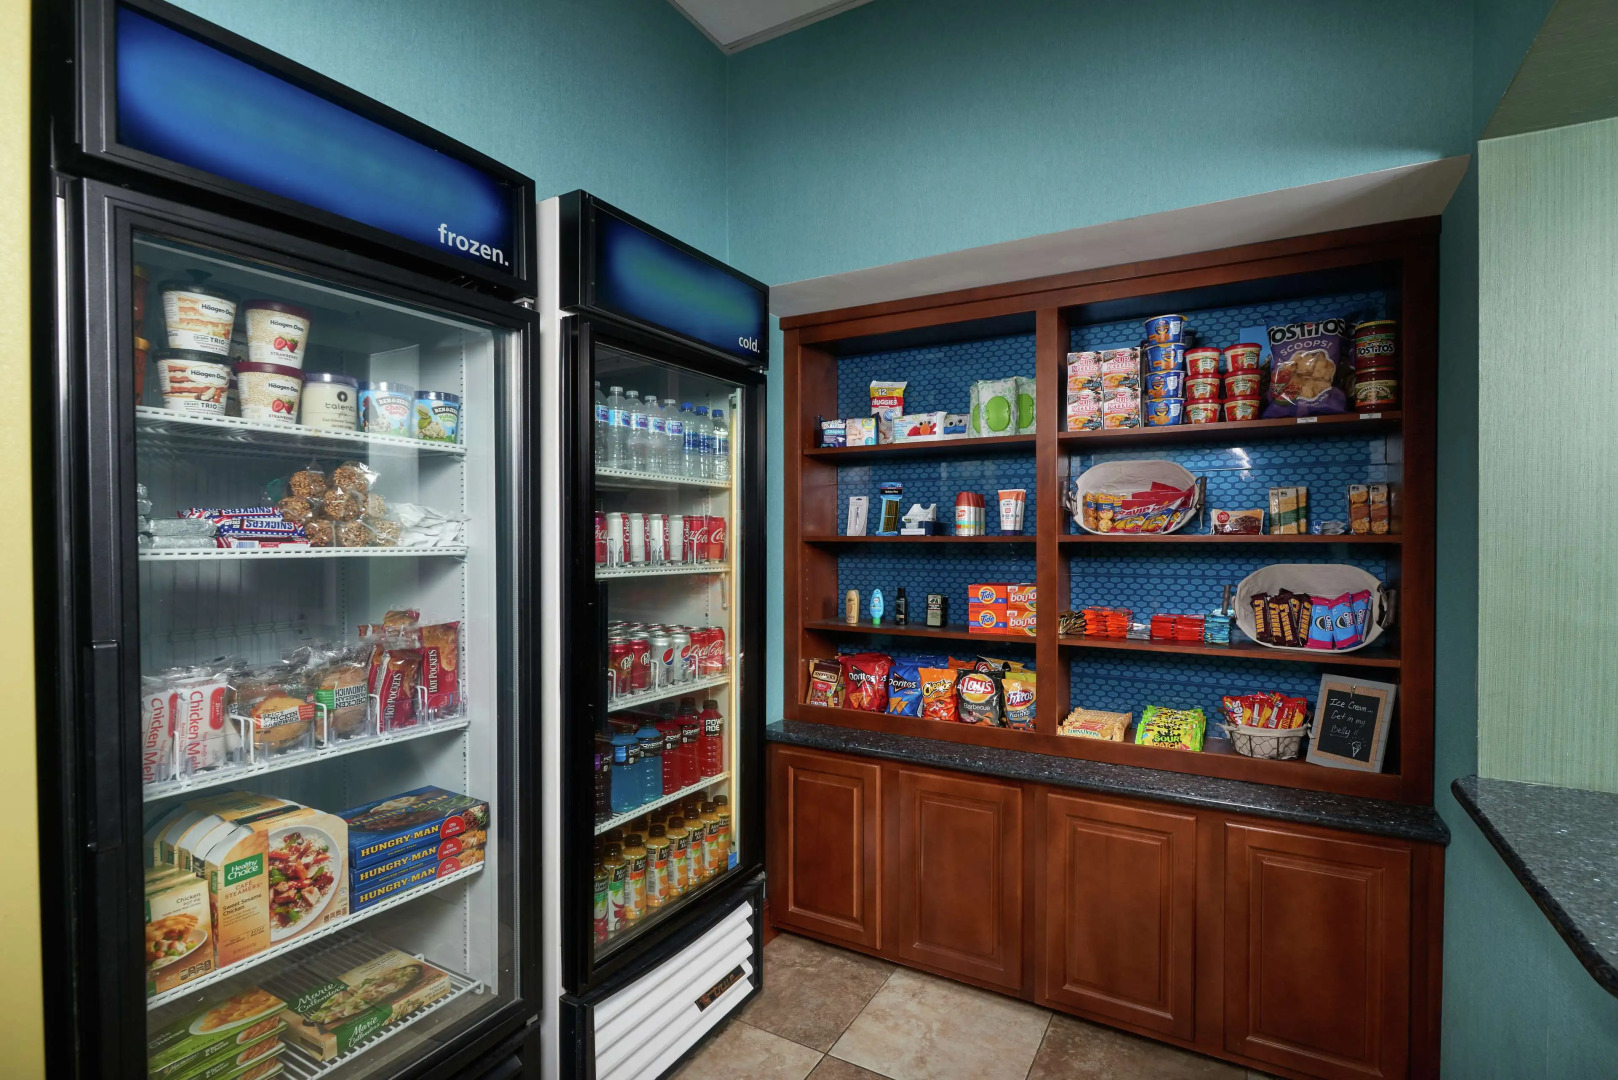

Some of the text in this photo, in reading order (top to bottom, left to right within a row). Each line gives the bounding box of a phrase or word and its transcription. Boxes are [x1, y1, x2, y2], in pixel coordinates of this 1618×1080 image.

[438, 224, 510, 266] frozen.
[210, 336, 225, 345] TRIO
[1267, 318, 1346, 345] TOSTITOS
[738, 335, 760, 353] cold.
[1280, 339, 1333, 356] SCOOPS!
[1357, 342, 1394, 356] TOSTITOS
[201, 402, 218, 410] TRIO
[871, 398, 897, 406] HUGGIES
[245, 520, 293, 530] SNICKERS
[981, 591, 995, 601] Tide
[981, 614, 995, 624] Tide
[1255, 608, 1265, 633] AVENUE
[1270, 610, 1282, 637] AVENUE
[1280, 611, 1293, 641] AVENUE
[1299, 609, 1311, 640] AVENUE
[428, 649, 438, 693] HOT POCKETS
[889, 678, 917, 689] Doritos
[922, 679, 953, 697] Cheetos
[963, 677, 992, 694] Lay's
[385, 673, 402, 718] HOT POCKETS
[1007, 690, 1033, 705] Fritos
[1330, 698, 1345, 708] Ice
[188, 690, 204, 741] Chicken
[963, 702, 991, 712] Barbecue
[145, 697, 164, 749] Chicken
[1331, 710, 1366, 728] Get in my
[1154, 735, 1180, 743] SOUR
[1331, 725, 1351, 738] Belly
[361, 825, 439, 857] HUNGRY-MAN
[228, 865, 259, 880] Choice
[231, 860, 258, 873] Healthy
[360, 846, 437, 881] HUNGRY-MAN
[360, 866, 436, 903] HUNGRY-MAN
[176, 892, 201, 904] Chicken
[222, 893, 262, 911] Sweet Sesame
[223, 905, 245, 916] Chicken
[295, 983, 337, 1009] Marie
[298, 984, 345, 1013] Callender's
[349, 1016, 378, 1041] Marie
